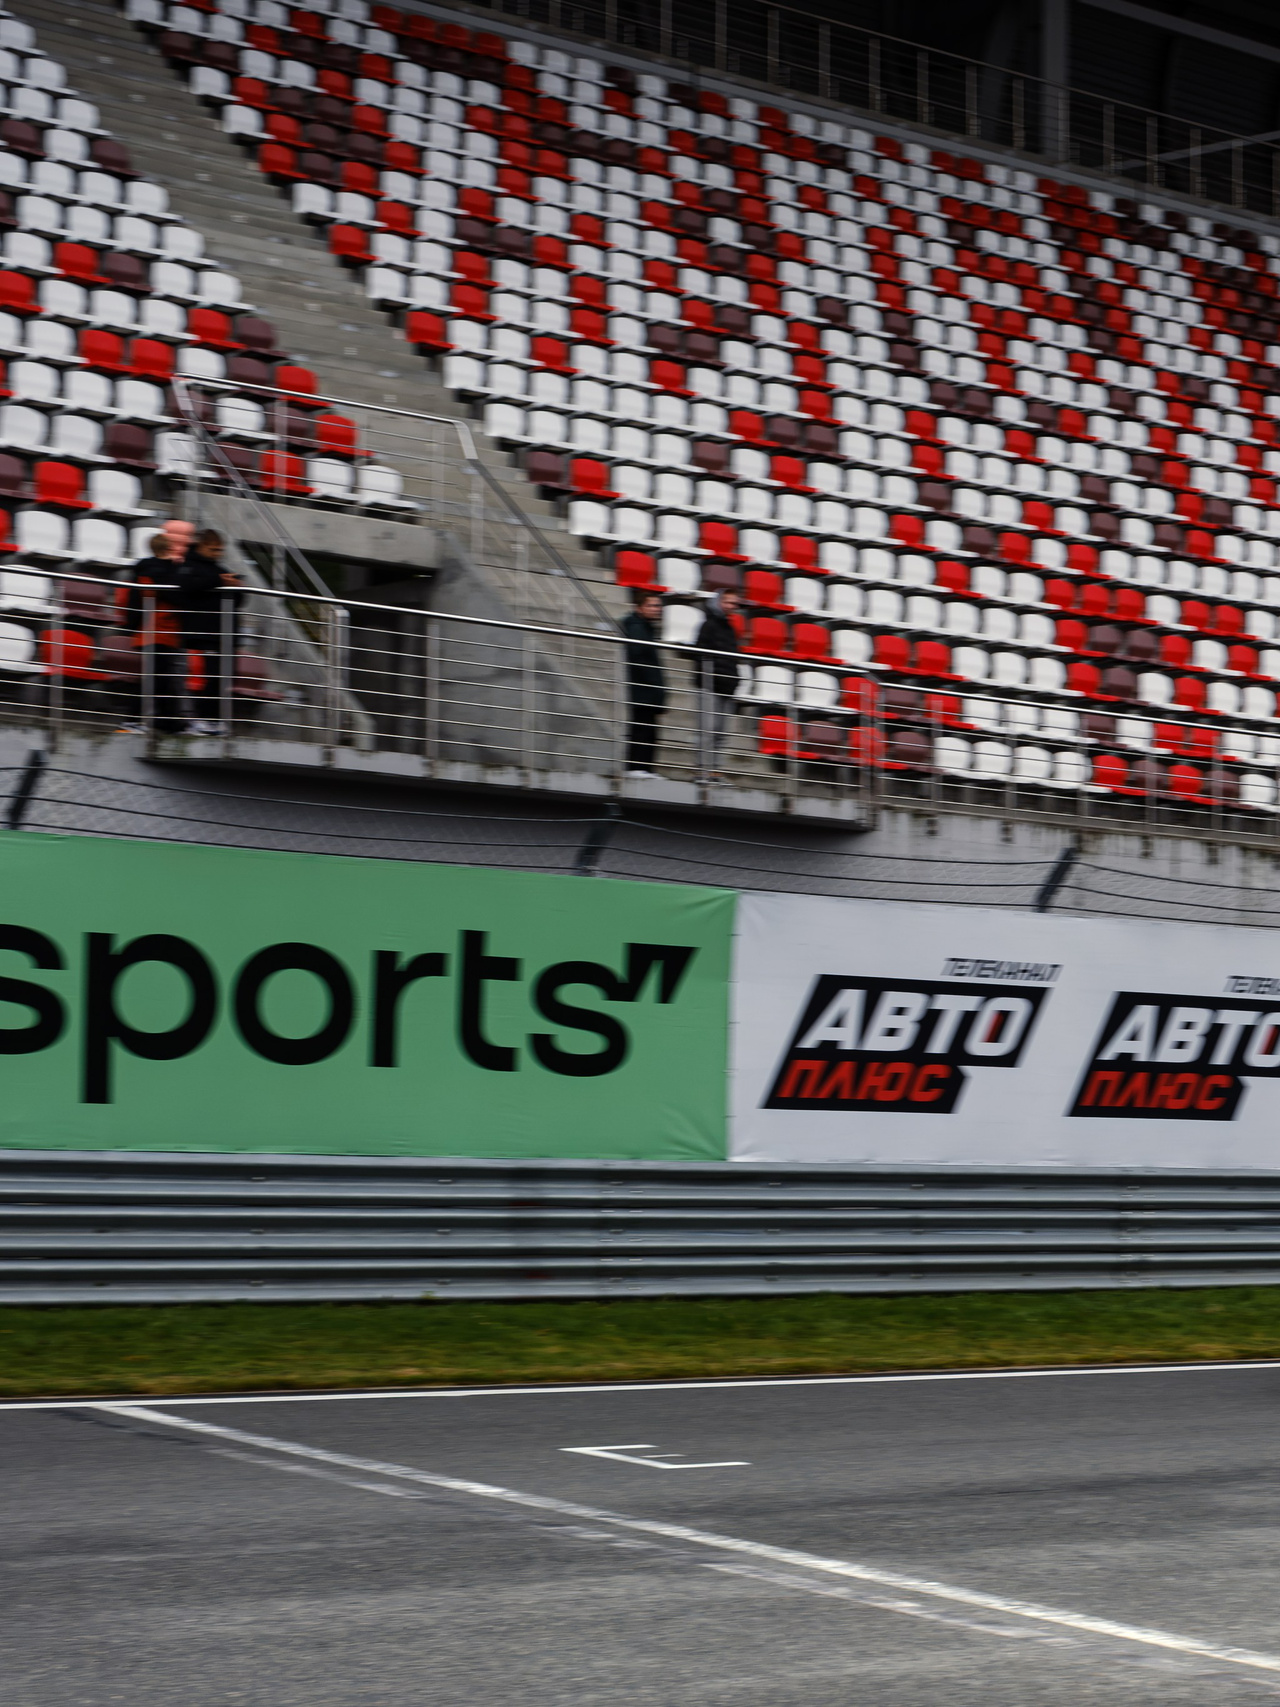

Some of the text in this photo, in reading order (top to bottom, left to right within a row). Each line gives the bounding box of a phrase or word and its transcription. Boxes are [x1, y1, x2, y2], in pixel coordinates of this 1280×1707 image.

[795, 988, 1036, 1057] АВТО
[776, 1060, 954, 1102] ПЛЮС
[1079, 1070, 1234, 1110] ПЛЮС
